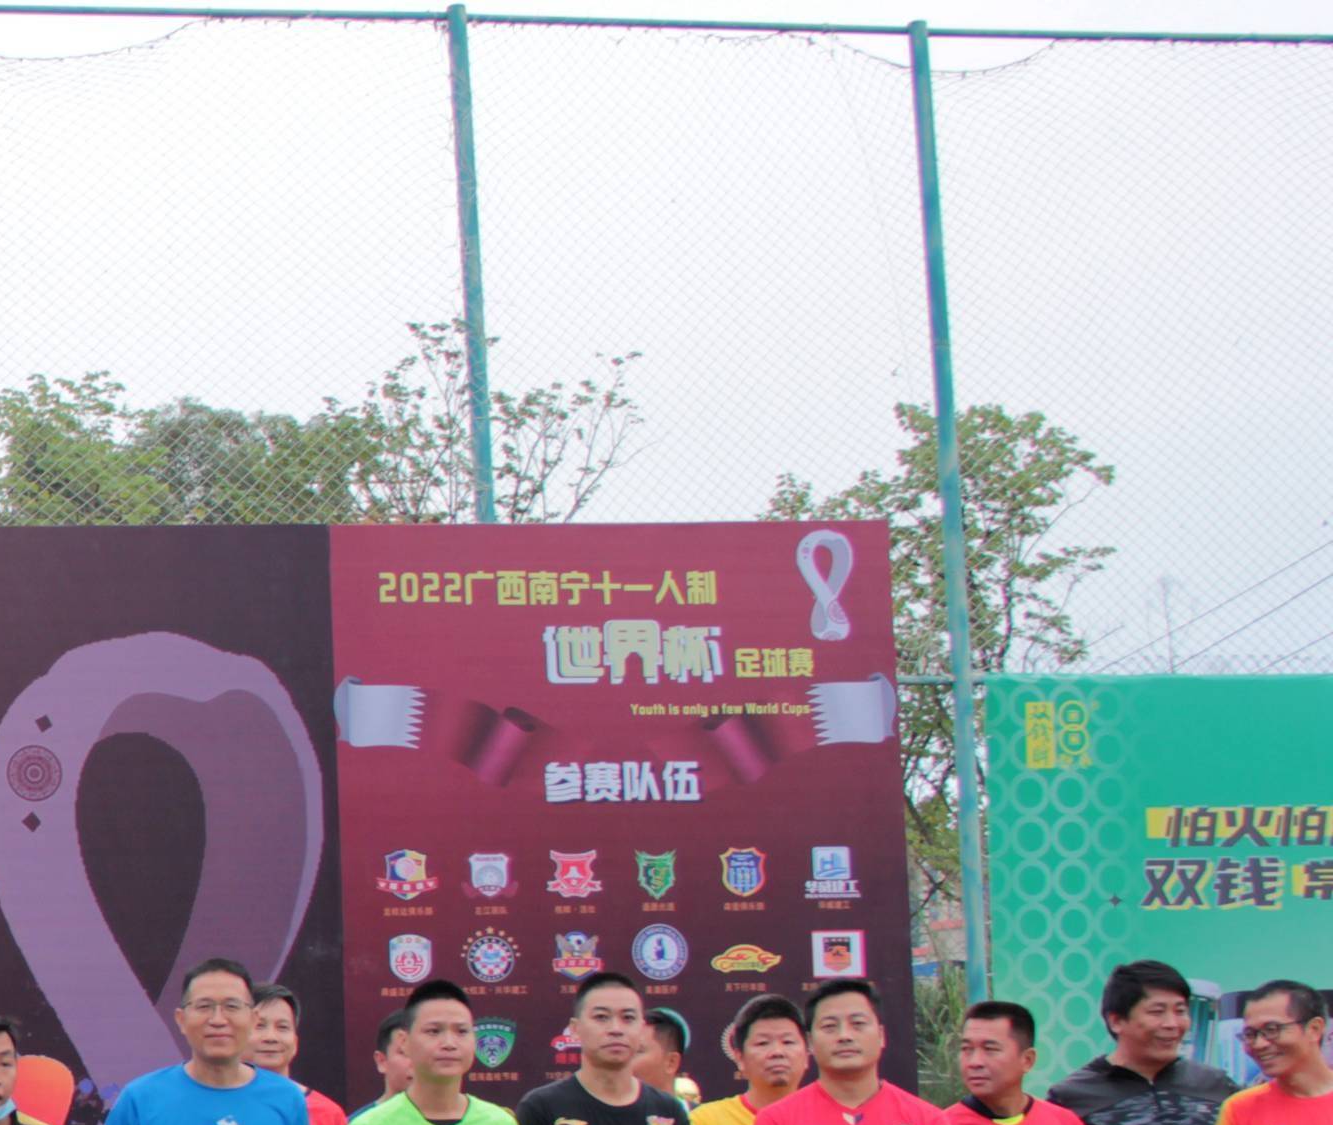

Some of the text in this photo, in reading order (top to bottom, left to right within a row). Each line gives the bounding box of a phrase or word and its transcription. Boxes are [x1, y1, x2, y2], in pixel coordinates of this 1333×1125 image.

[378, 570, 717, 606] 2022广西南宁十一人制
[542, 618, 814, 684] 世界杯 足球赛
[630, 703, 811, 718] Youth is only a few World Cups
[545, 761, 701, 802] 参赛队伍
[1141, 857, 1282, 908] 双钱
